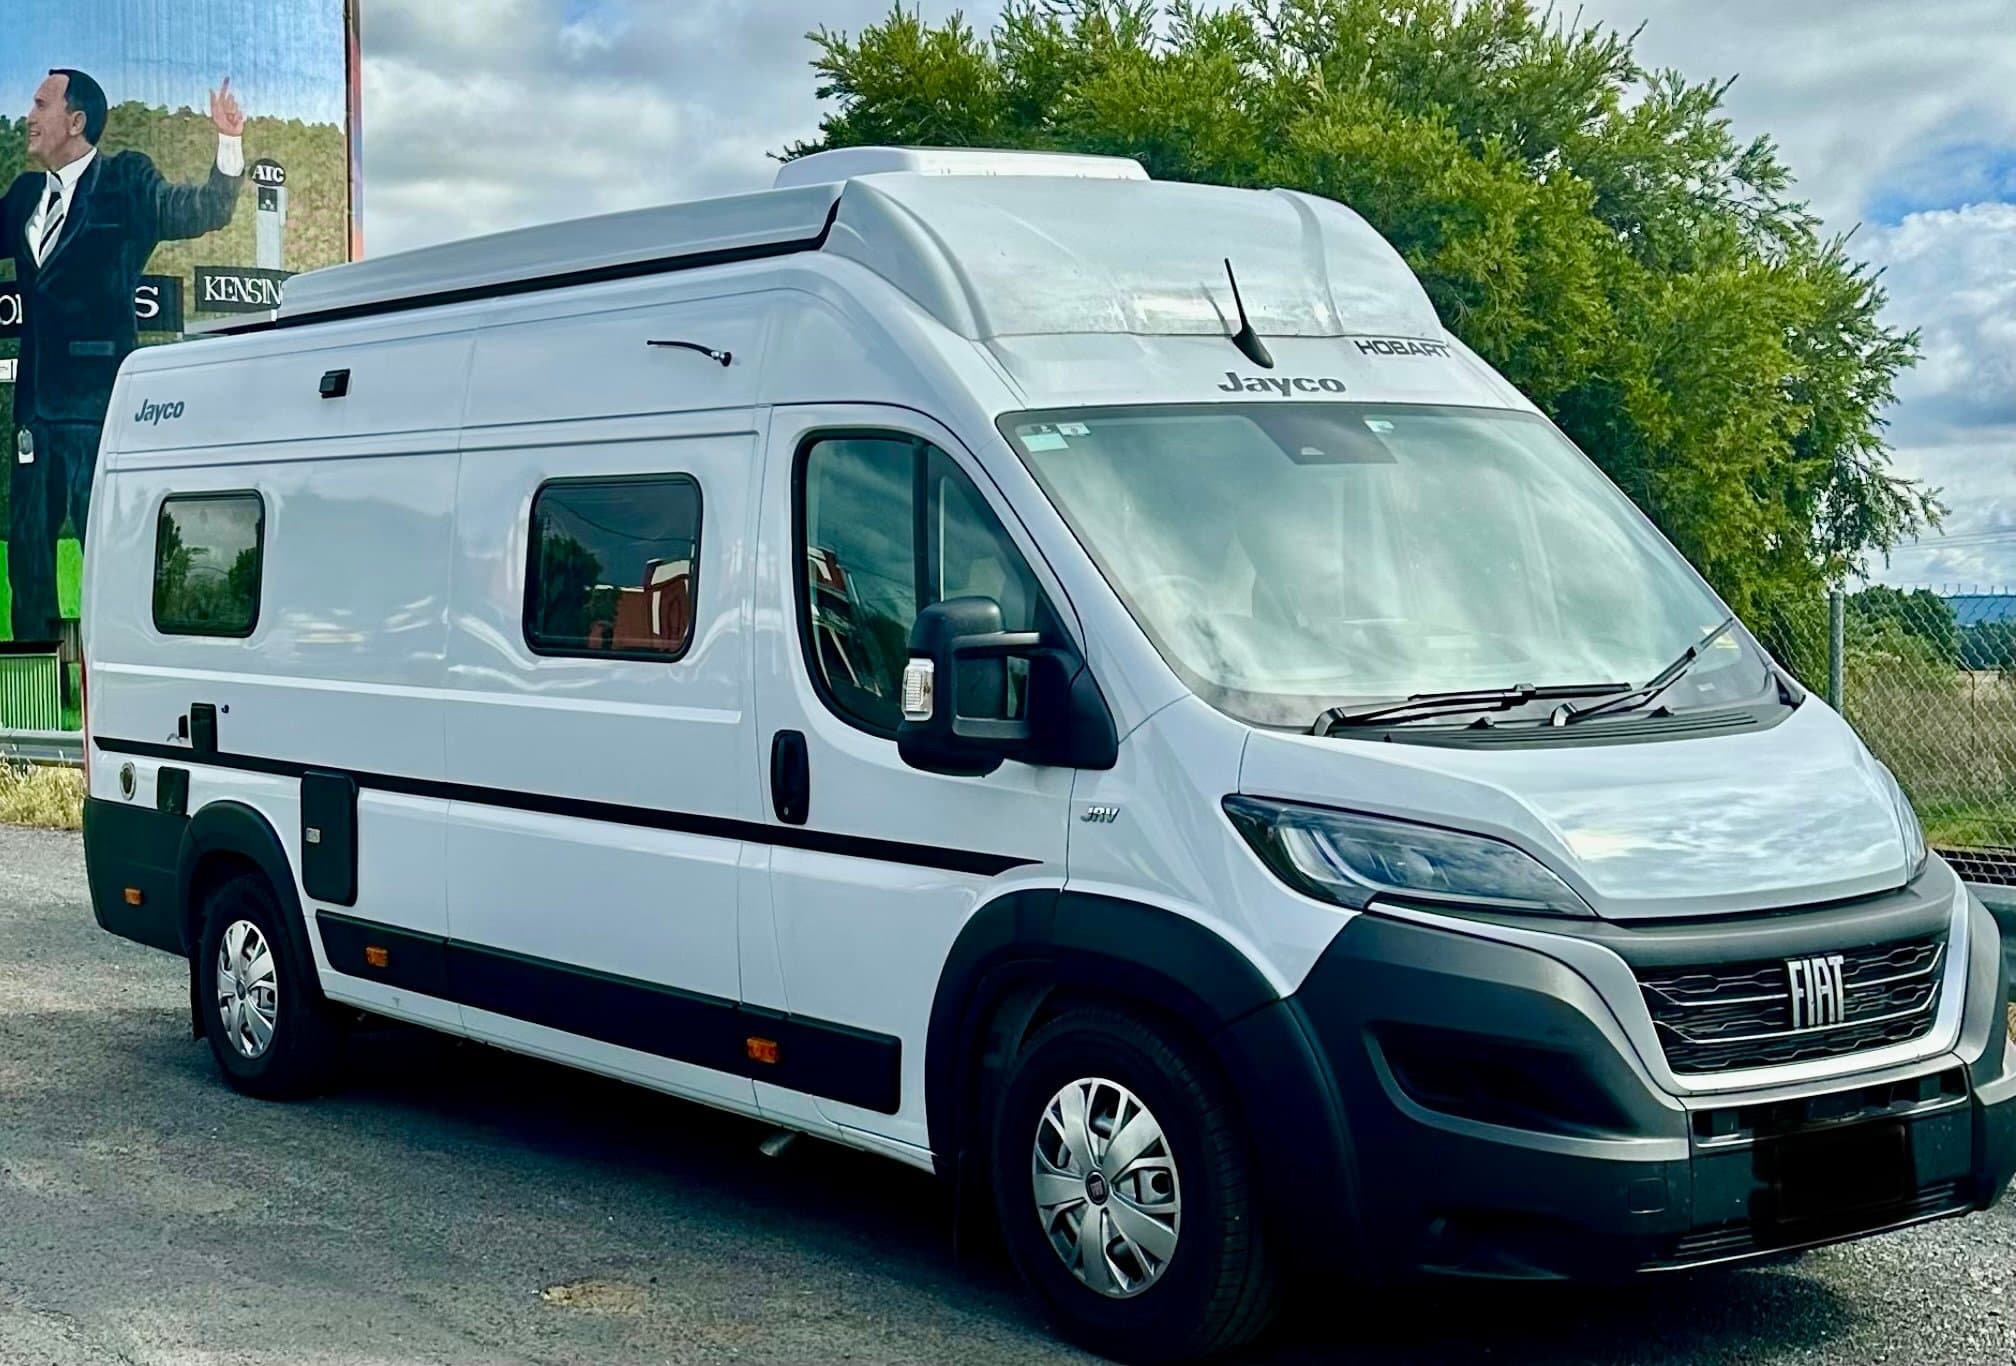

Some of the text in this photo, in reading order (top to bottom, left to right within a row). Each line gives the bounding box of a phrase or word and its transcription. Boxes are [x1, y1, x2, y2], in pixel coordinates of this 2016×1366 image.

[203, 276, 283, 305] KENSIN
[1354, 339, 1451, 358] HOBART
[1218, 371, 1346, 397] Jayco
[134, 398, 185, 426] Jayco
[1787, 954, 1845, 1029] FIAT
